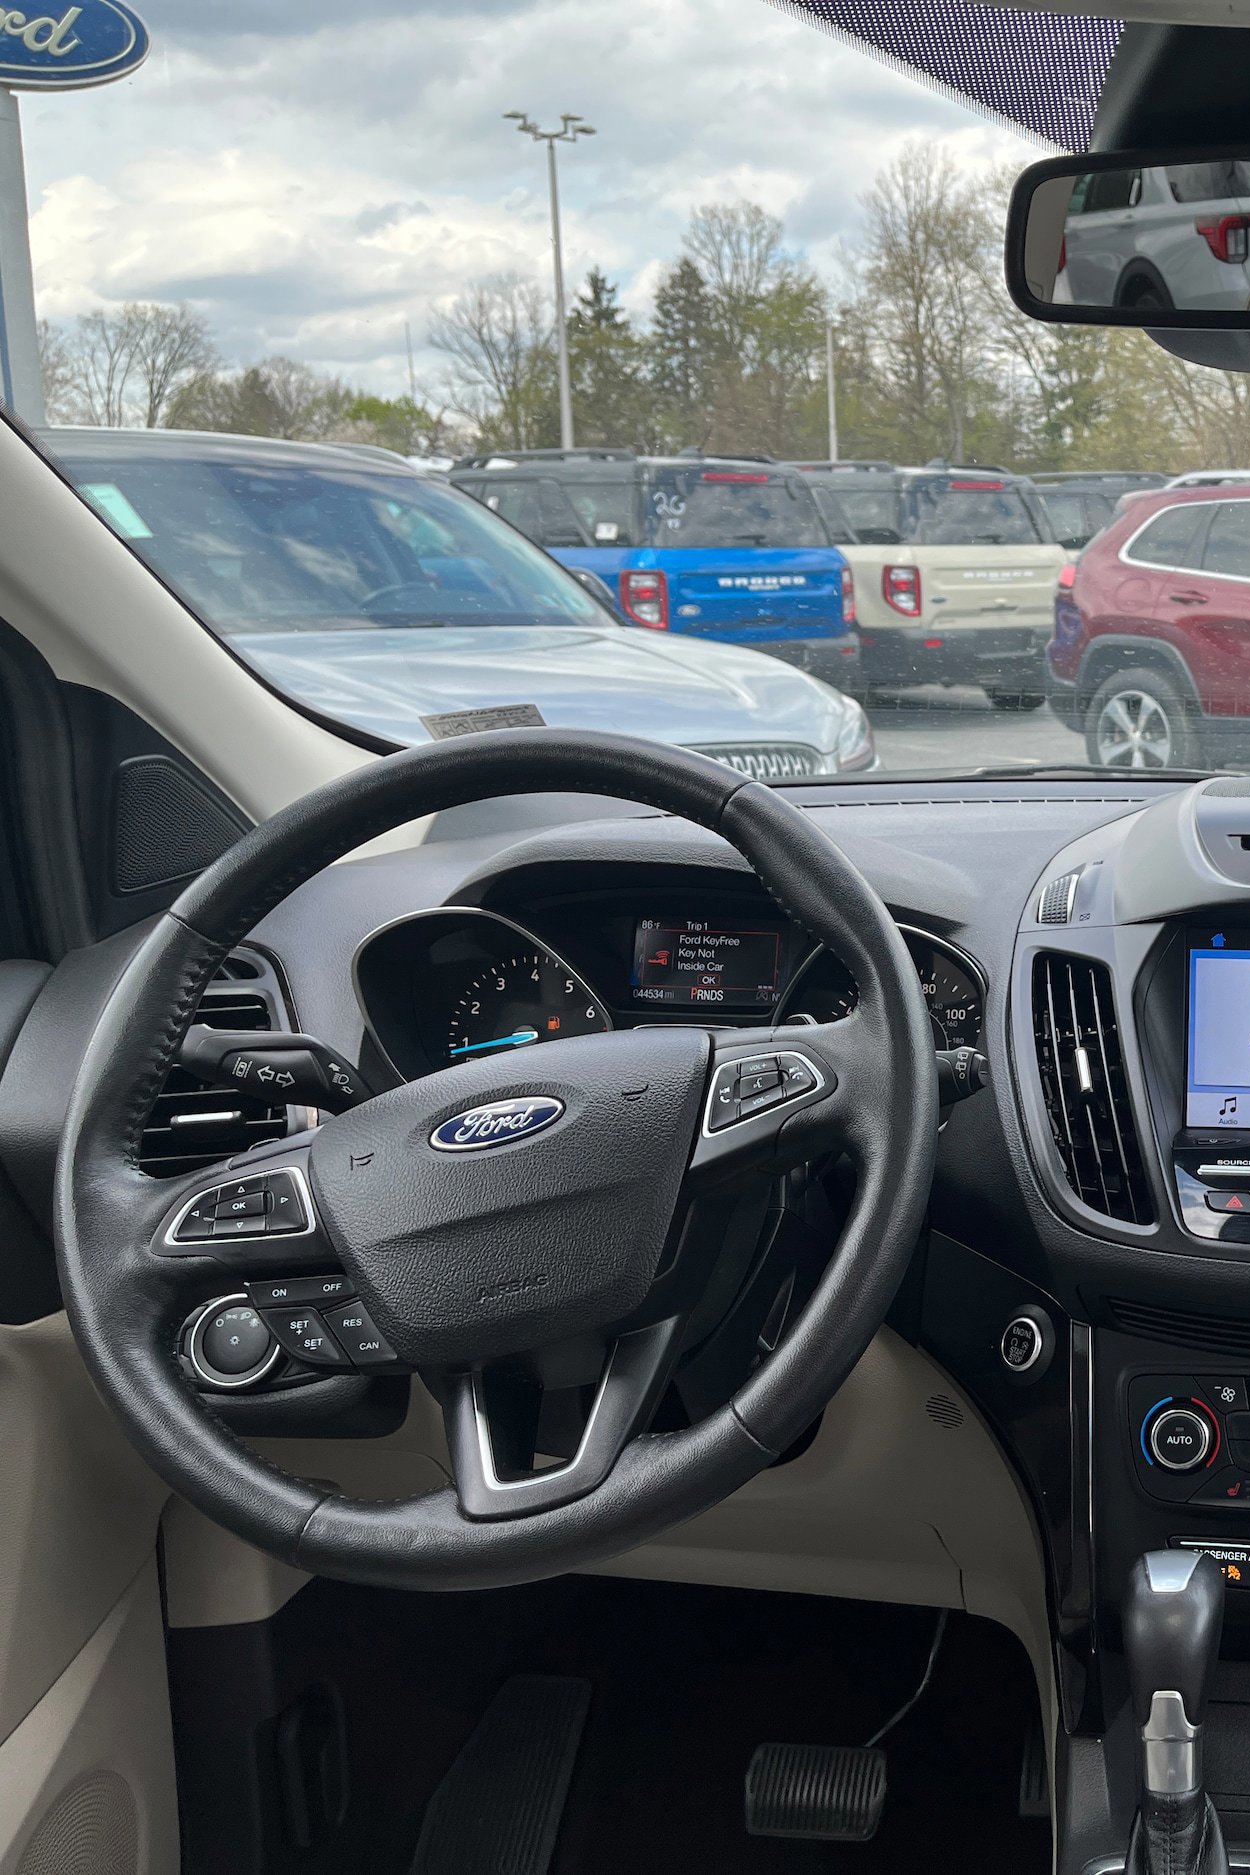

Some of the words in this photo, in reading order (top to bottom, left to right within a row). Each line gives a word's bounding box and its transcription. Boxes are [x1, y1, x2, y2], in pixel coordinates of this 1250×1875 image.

[0, 7, 83, 56] rd
[686, 921, 702, 931] Trip
[704, 922, 708, 931] 1
[680, 935, 701, 945] Ford
[703, 936, 740, 947] KeyFree
[679, 948, 697, 958] Key
[698, 949, 715, 959] Not
[677, 961, 705, 971] Inside
[707, 962, 724, 972] Car
[531, 969, 540, 981] 4
[702, 976, 716, 985] OK
[496, 978, 505, 990] 3
[564, 980, 574, 993] 5
[922, 984, 936, 994] 80
[471, 1003, 480, 1014] 2
[586, 1006, 595, 1018] 6
[945, 1009, 966, 1020] 100
[462, 1037, 469, 1048] 1
[454, 1104, 534, 1142] Ford
[232, 1202, 246, 1210] OK
[272, 1289, 287, 1298] ON
[323, 1283, 342, 1292] OFF
[290, 1320, 309, 1330] SET
[343, 1318, 362, 1327] RES
[1013, 1326, 1032, 1339] ENGINE
[304, 1338, 323, 1347] SET
[359, 1342, 379, 1351] CAN
[1009, 1346, 1026, 1358] START
[1008, 1353, 1023, 1363] STOP
[1167, 1436, 1193, 1445] AUTO
[1194, 1549, 1247, 1562] SENGER
